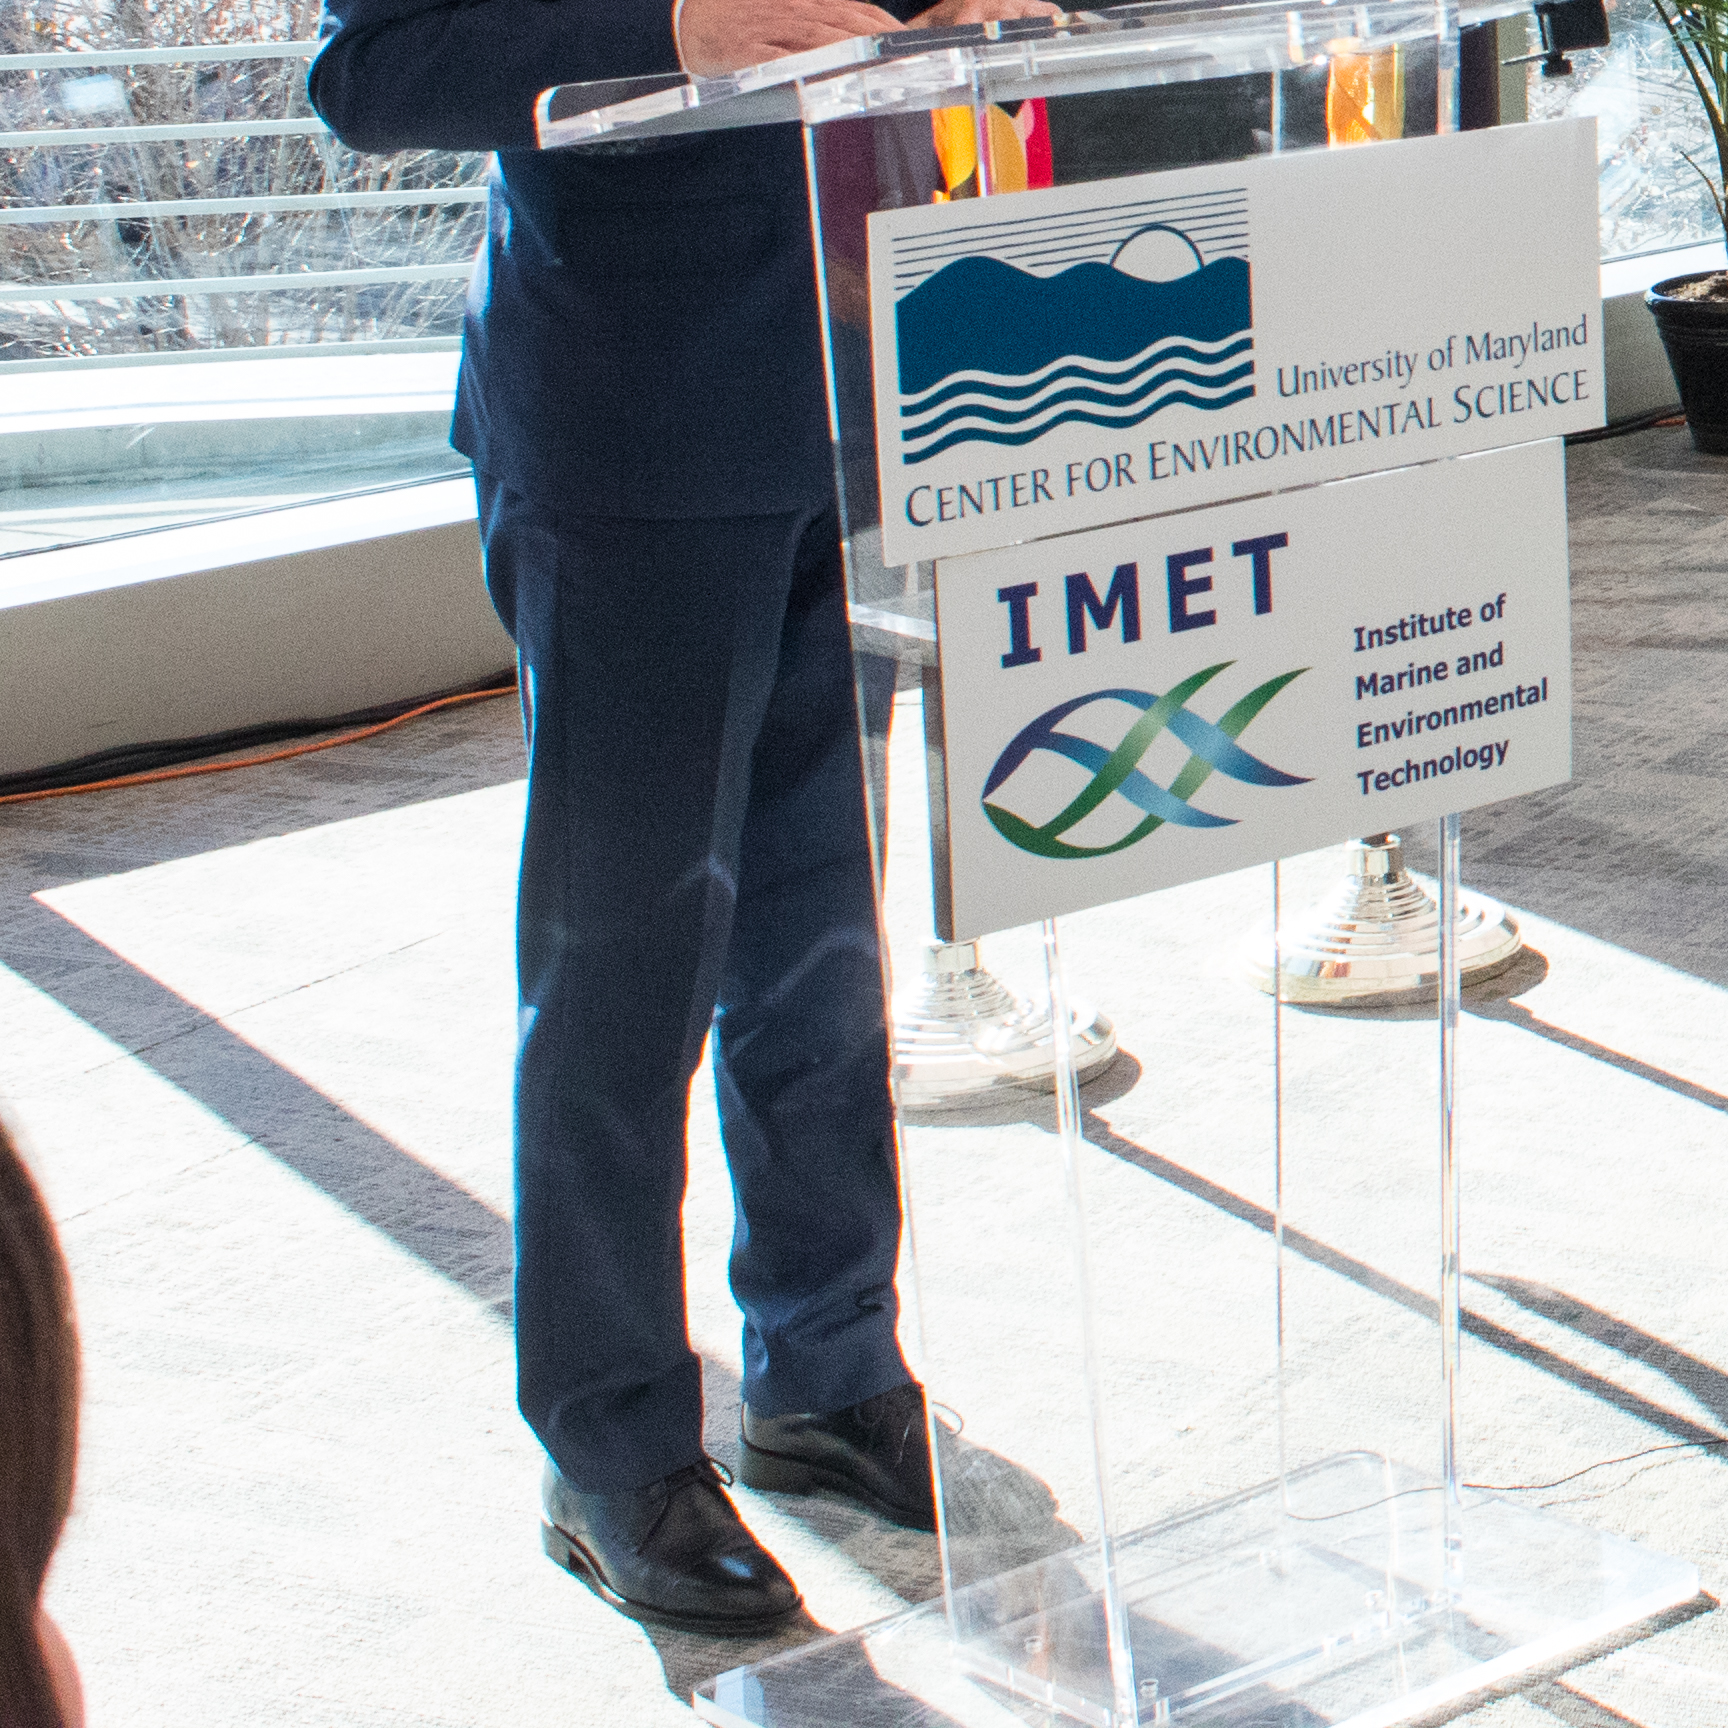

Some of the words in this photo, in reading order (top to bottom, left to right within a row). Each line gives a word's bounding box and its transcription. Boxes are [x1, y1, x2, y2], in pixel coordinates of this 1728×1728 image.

[1276, 348, 1418, 397] University
[1426, 335, 1457, 372] of
[1465, 315, 1589, 372] Maryland
[904, 466, 1054, 527] CENTER
[1066, 452, 1134, 495] FOR
[1147, 397, 1440, 481] ENVIRONMENTAL
[1452, 369, 1590, 424] SCIENCE
[997, 532, 1290, 669] IMET
[1353, 605, 1472, 653] Institute
[1479, 593, 1507, 624] of
[1355, 659, 1450, 701] Marine
[1456, 643, 1504, 680] and
[1357, 678, 1549, 749] Environmental
[1357, 737, 1509, 795] Technology
